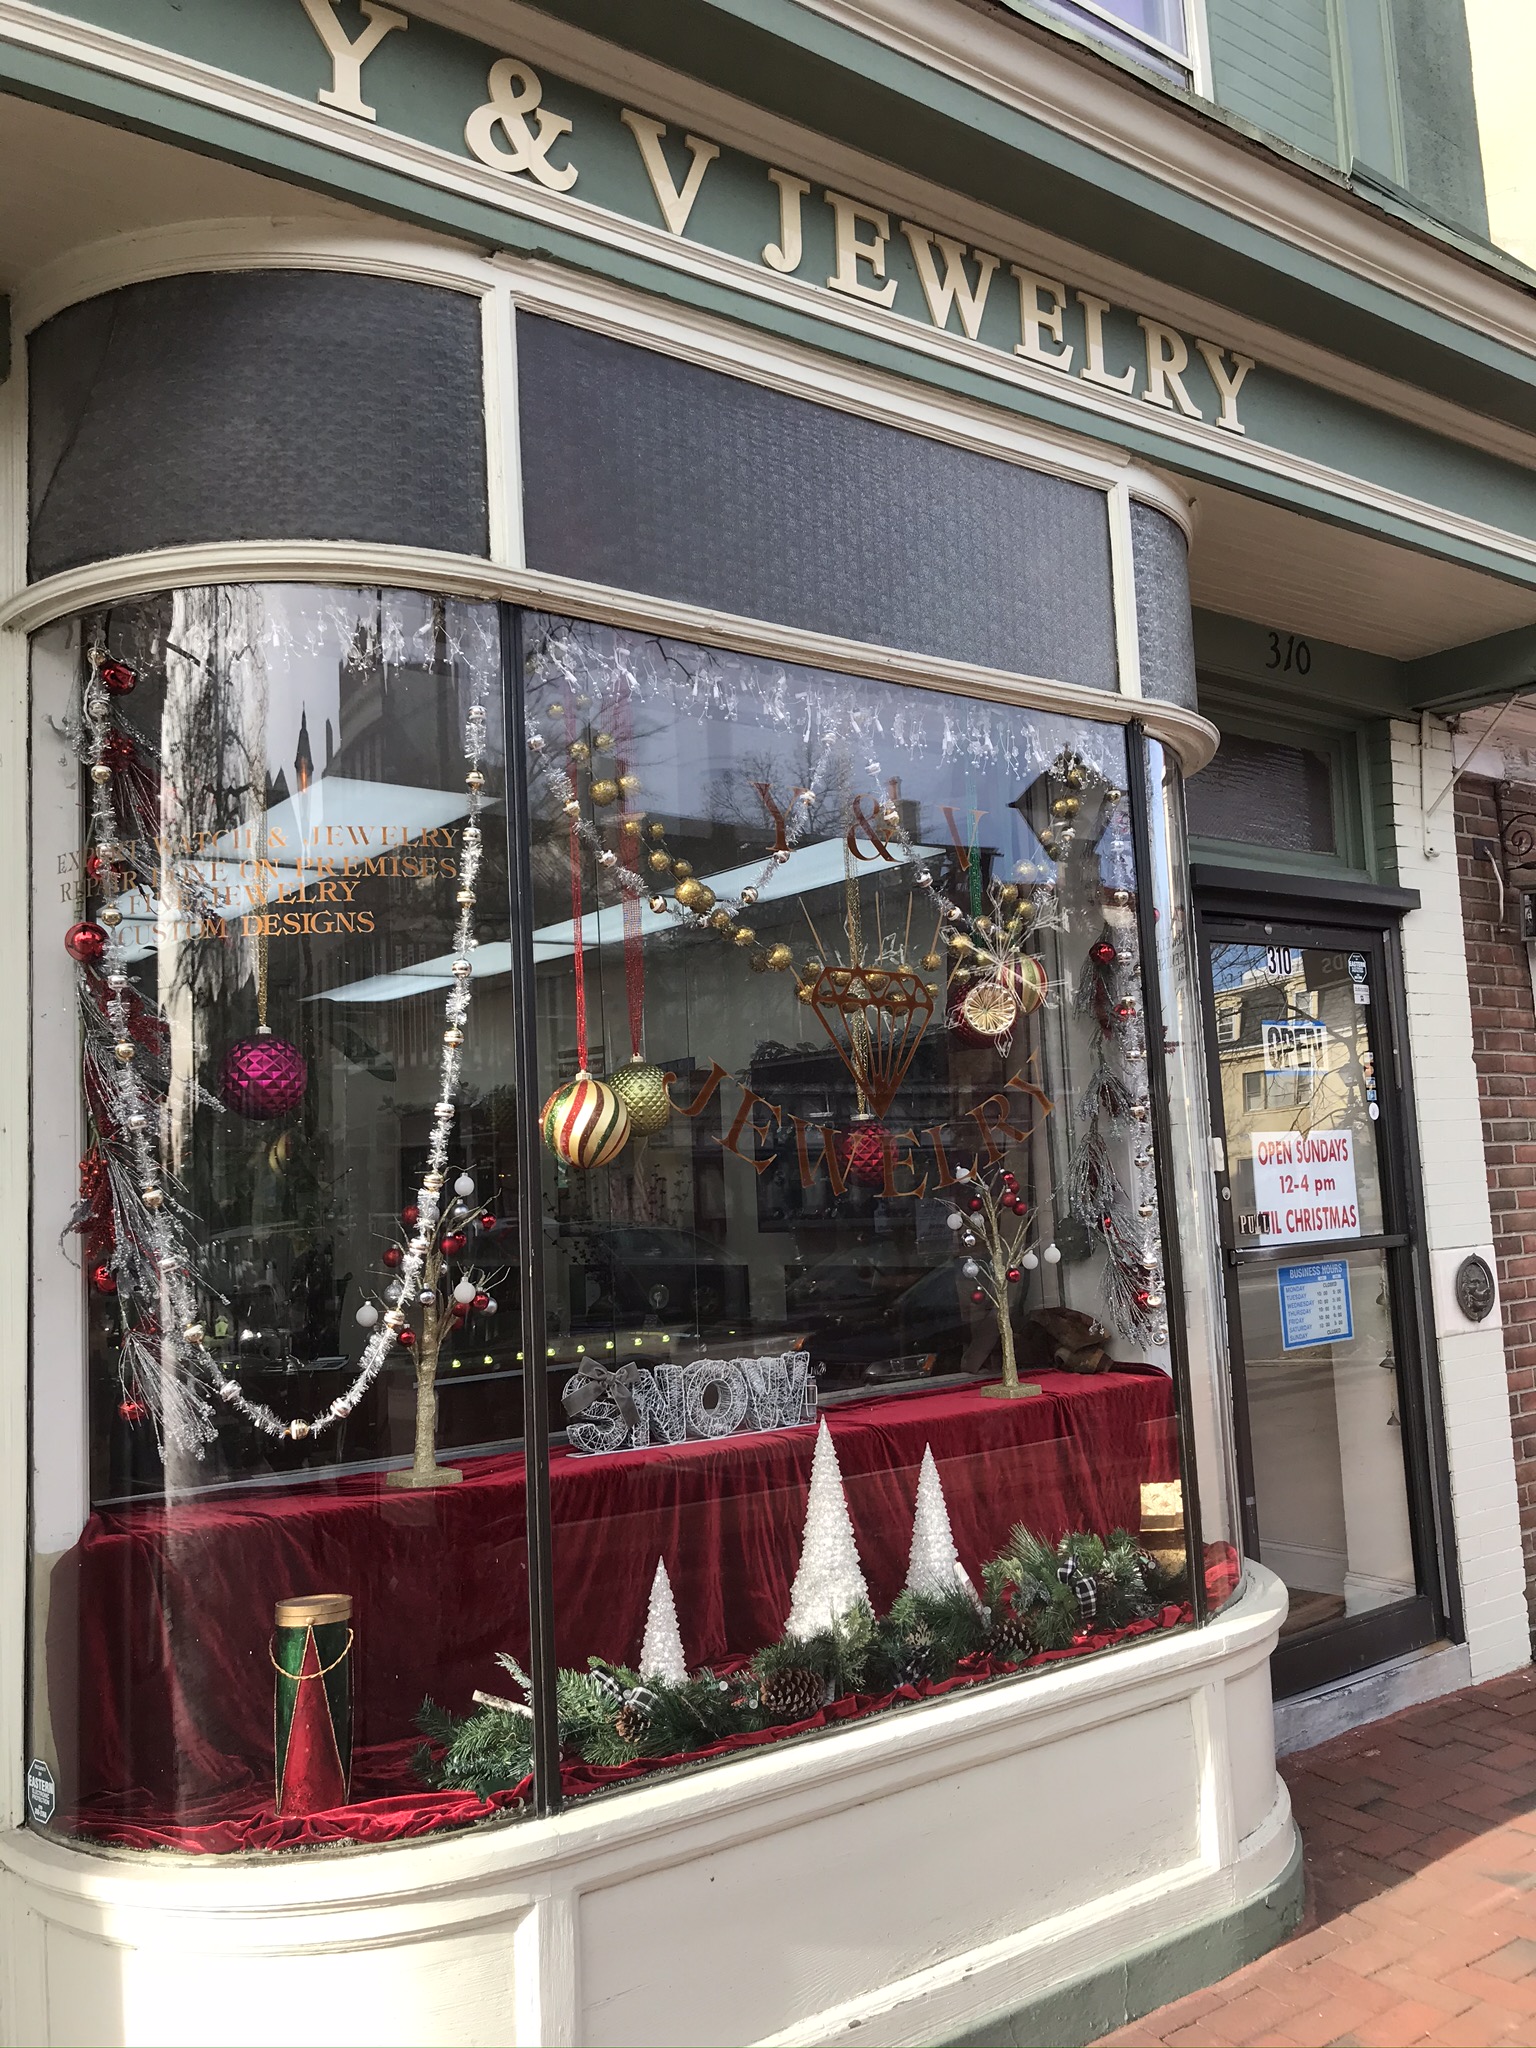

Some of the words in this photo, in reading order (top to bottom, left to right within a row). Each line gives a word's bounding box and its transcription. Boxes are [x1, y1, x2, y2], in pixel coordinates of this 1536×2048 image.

[301, 0, 408, 121] Y
[465, 58, 579, 191] &
[621, 108, 720, 236] V
[761, 168, 1255, 435] JEWELRY
[1266, 632, 1311, 675] 310
[749, 782, 808, 852] Y
[846, 794, 902, 863] &
[936, 806, 988, 871] V
[57, 840, 138, 874] EXPRT
[267, 826, 287, 848] &
[303, 825, 459, 848] JEWELRY
[240, 858, 281, 880] ON
[295, 856, 457, 878] PREMISES
[203, 881, 360, 909] JEWELRY
[118, 917, 228, 947] CUSTOM
[241, 910, 375, 937] DESIGNS
[1268, 946, 1291, 975] 310
[1268, 1027, 1323, 1068] OPEN
[662, 1048, 1055, 1199] JEWELRY
[1258, 1141, 1292, 1165] OPEN
[1296, 1139, 1348, 1163] SUNDAYS
[1279, 1174, 1309, 1194] 12-4
[1314, 1178, 1335, 1196] pm
[1286, 1205, 1356, 1233] CHRISTMAS
[1290, 1266, 1320, 1278] BUSINESS
[1321, 1264, 1342, 1274] HOURS
[561, 1351, 810, 1453] SNOW
